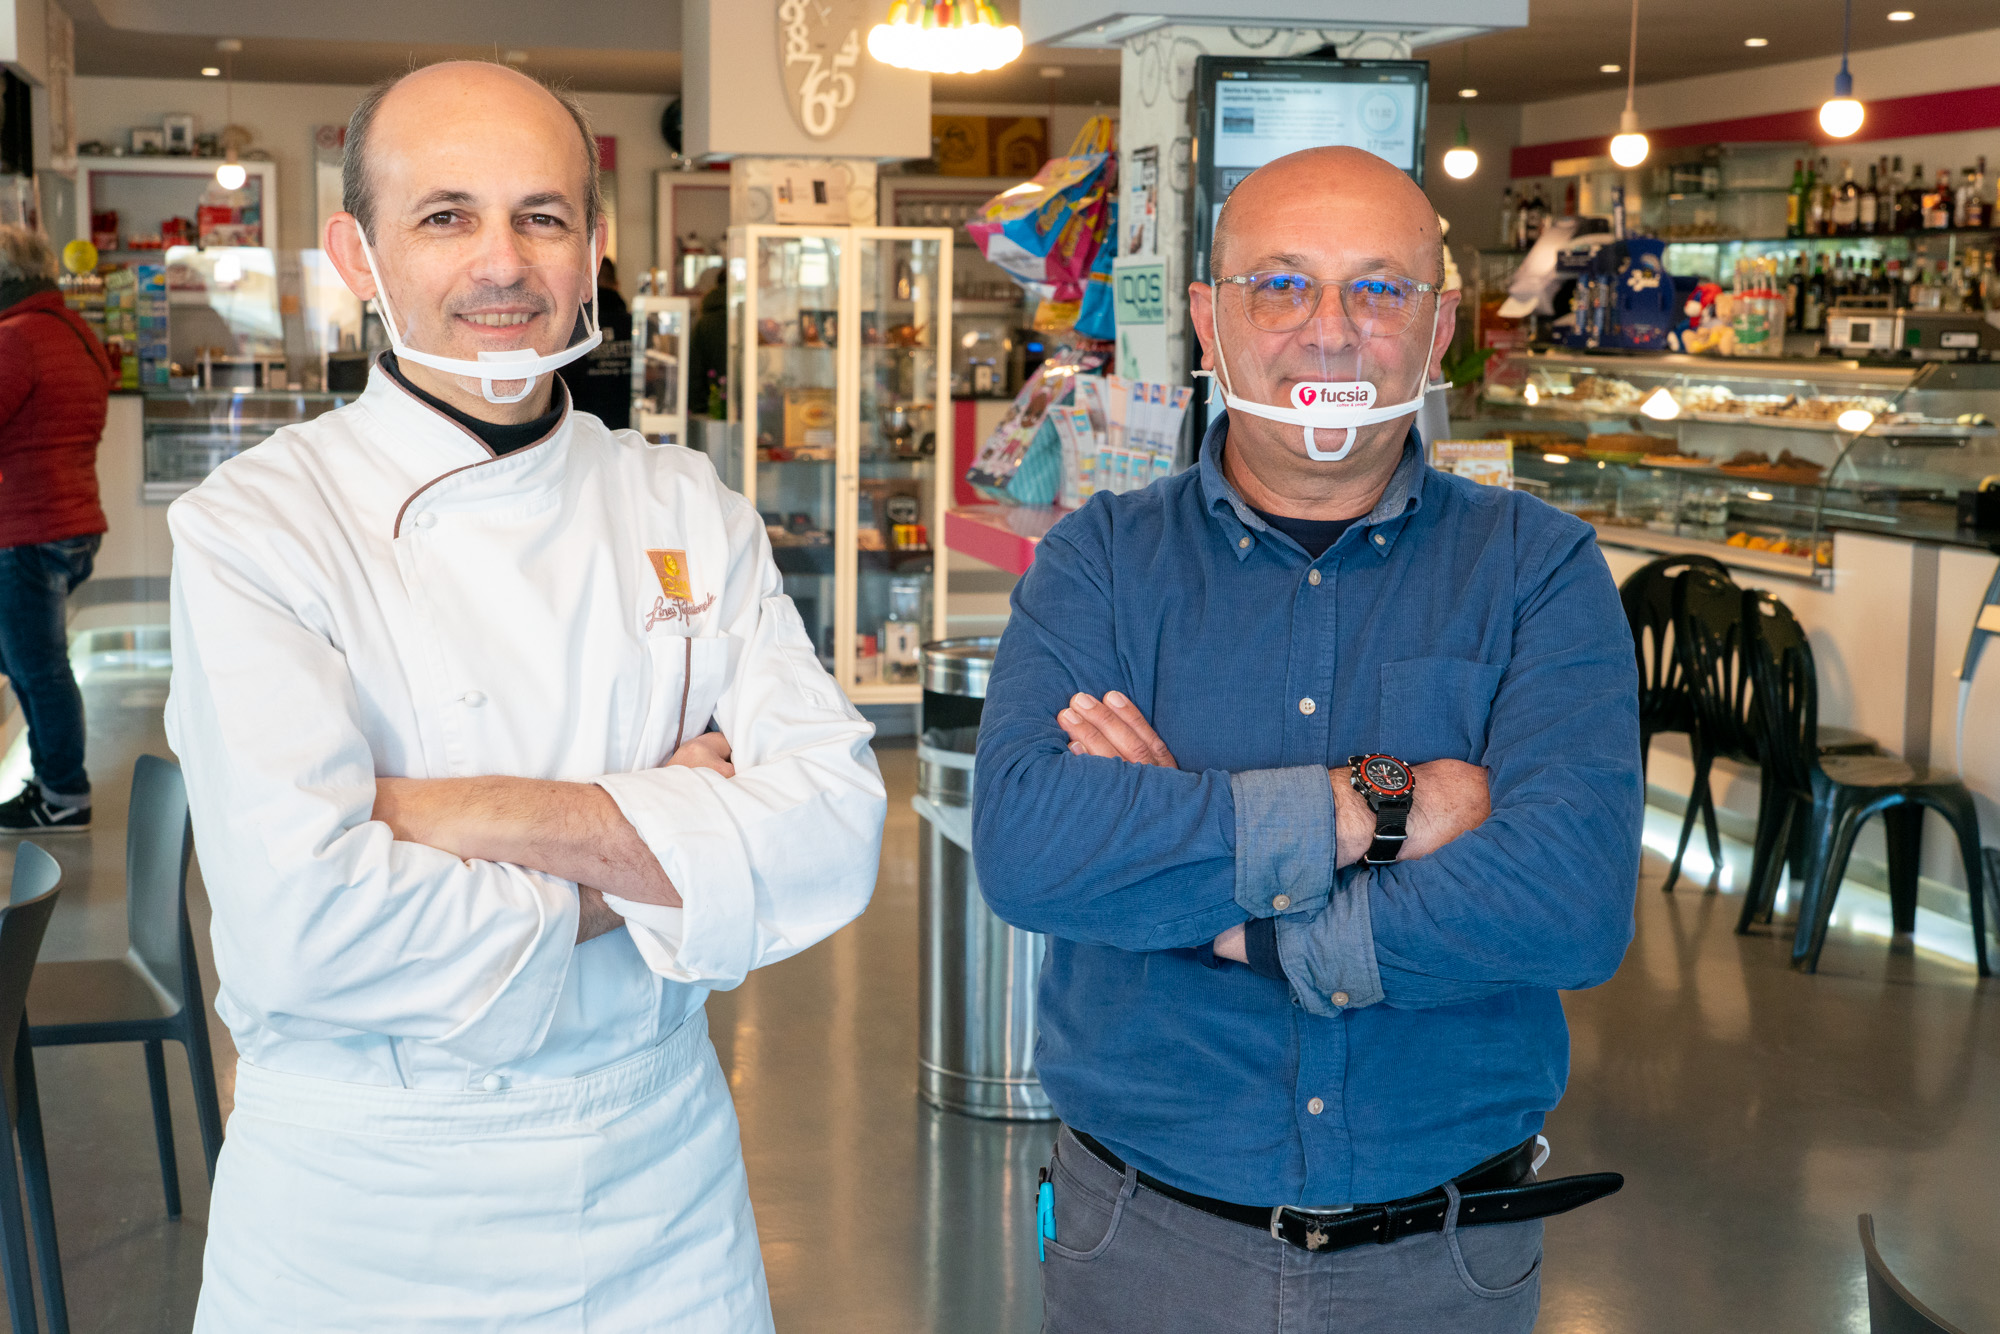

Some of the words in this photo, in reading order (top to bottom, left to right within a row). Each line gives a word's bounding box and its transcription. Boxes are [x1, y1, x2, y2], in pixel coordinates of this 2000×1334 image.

[785, 53, 822, 96] 7
[830, 54, 855, 108] 5
[801, 69, 837, 136] 6
[1320, 386, 1368, 402] fucsia
